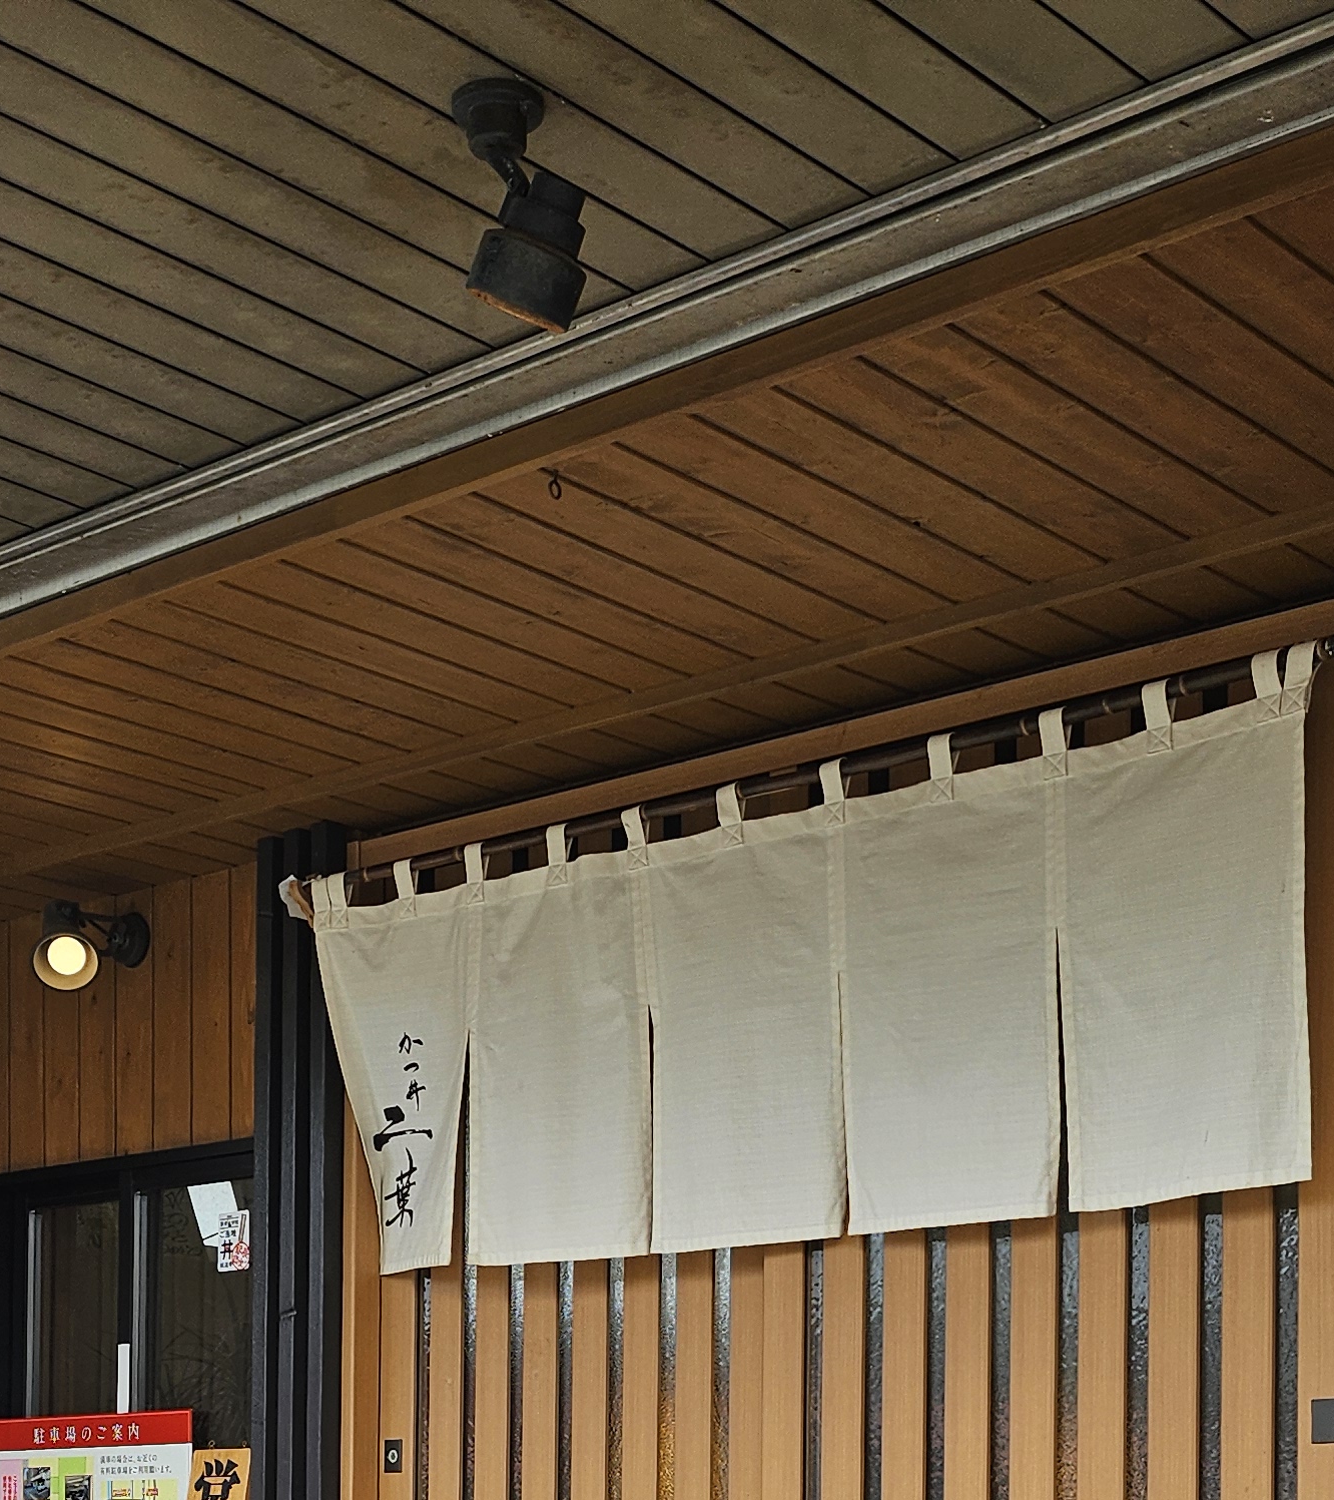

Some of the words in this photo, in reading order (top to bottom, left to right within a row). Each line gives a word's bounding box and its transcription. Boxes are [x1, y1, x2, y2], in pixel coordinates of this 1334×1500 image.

[33, 1422, 140, 1445] 駐車場のご案内
